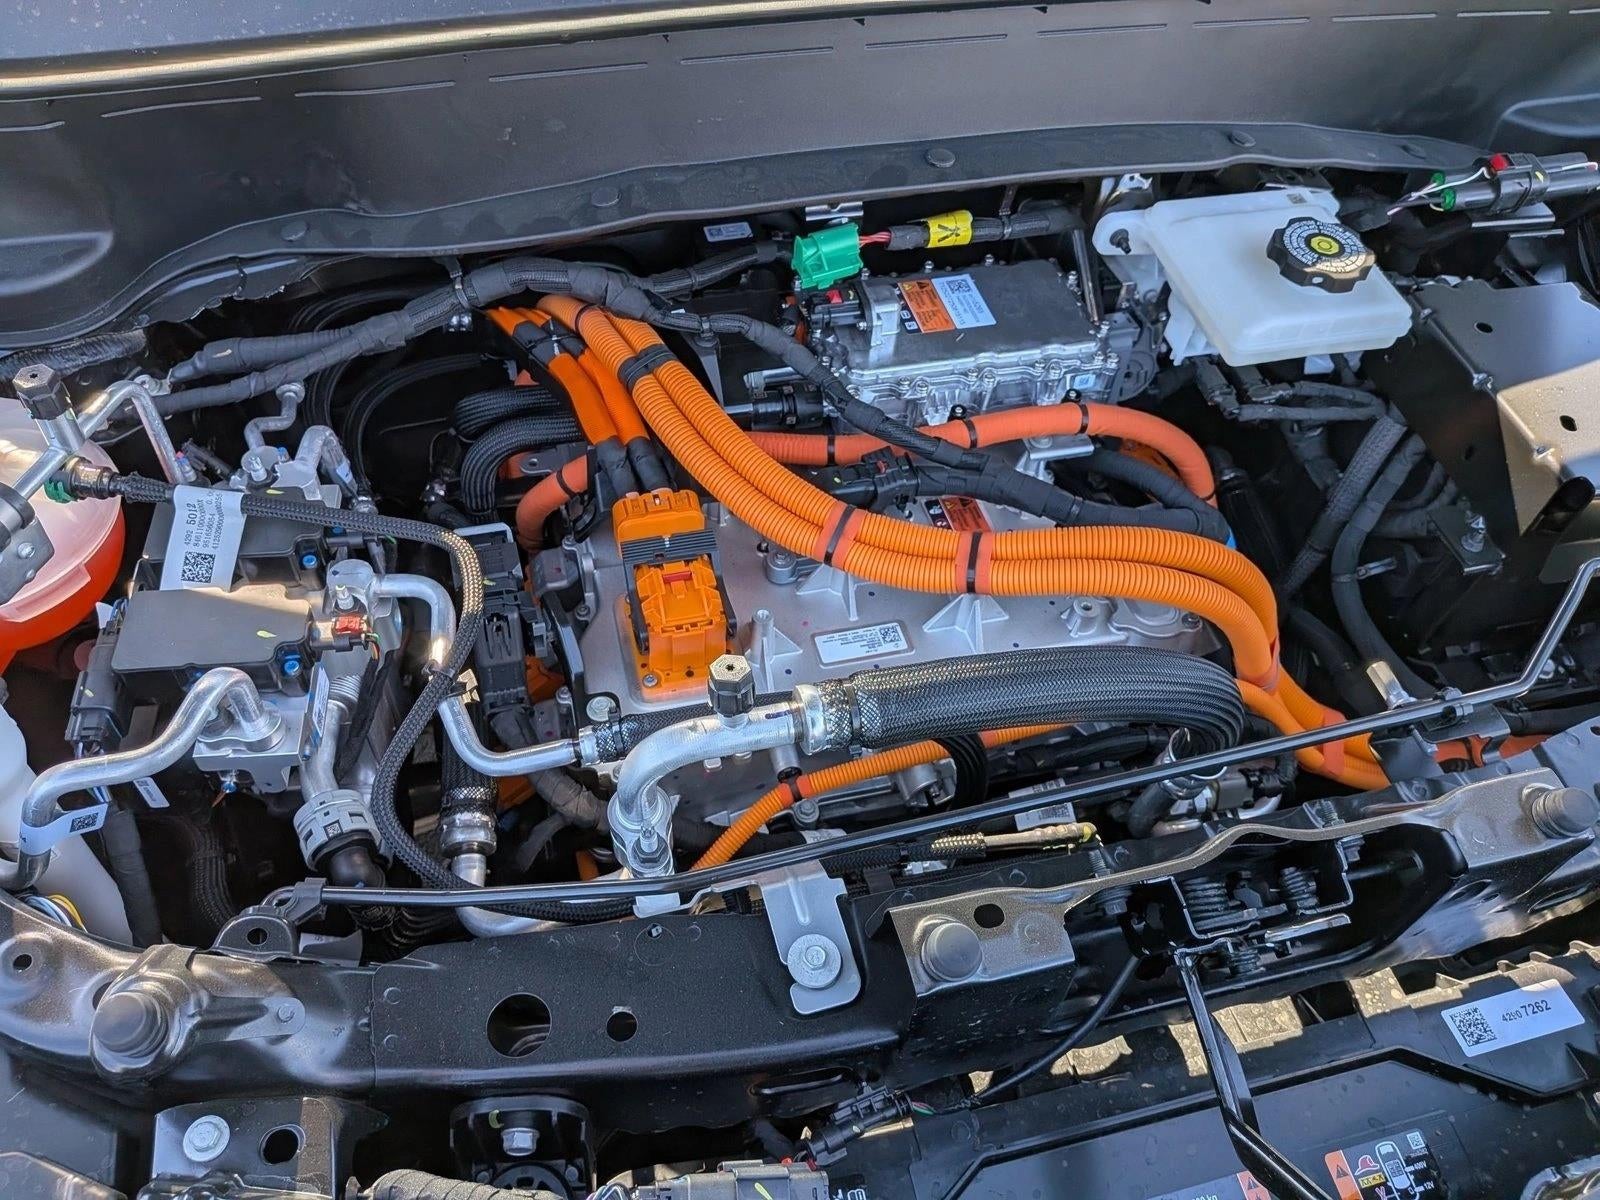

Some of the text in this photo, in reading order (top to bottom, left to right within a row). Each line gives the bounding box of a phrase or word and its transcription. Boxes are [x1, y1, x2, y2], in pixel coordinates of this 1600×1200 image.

[186, 502, 198, 525] 5012
[1520, 999, 1551, 1016] 7262
[1423, 1181, 1434, 1190] 12V
